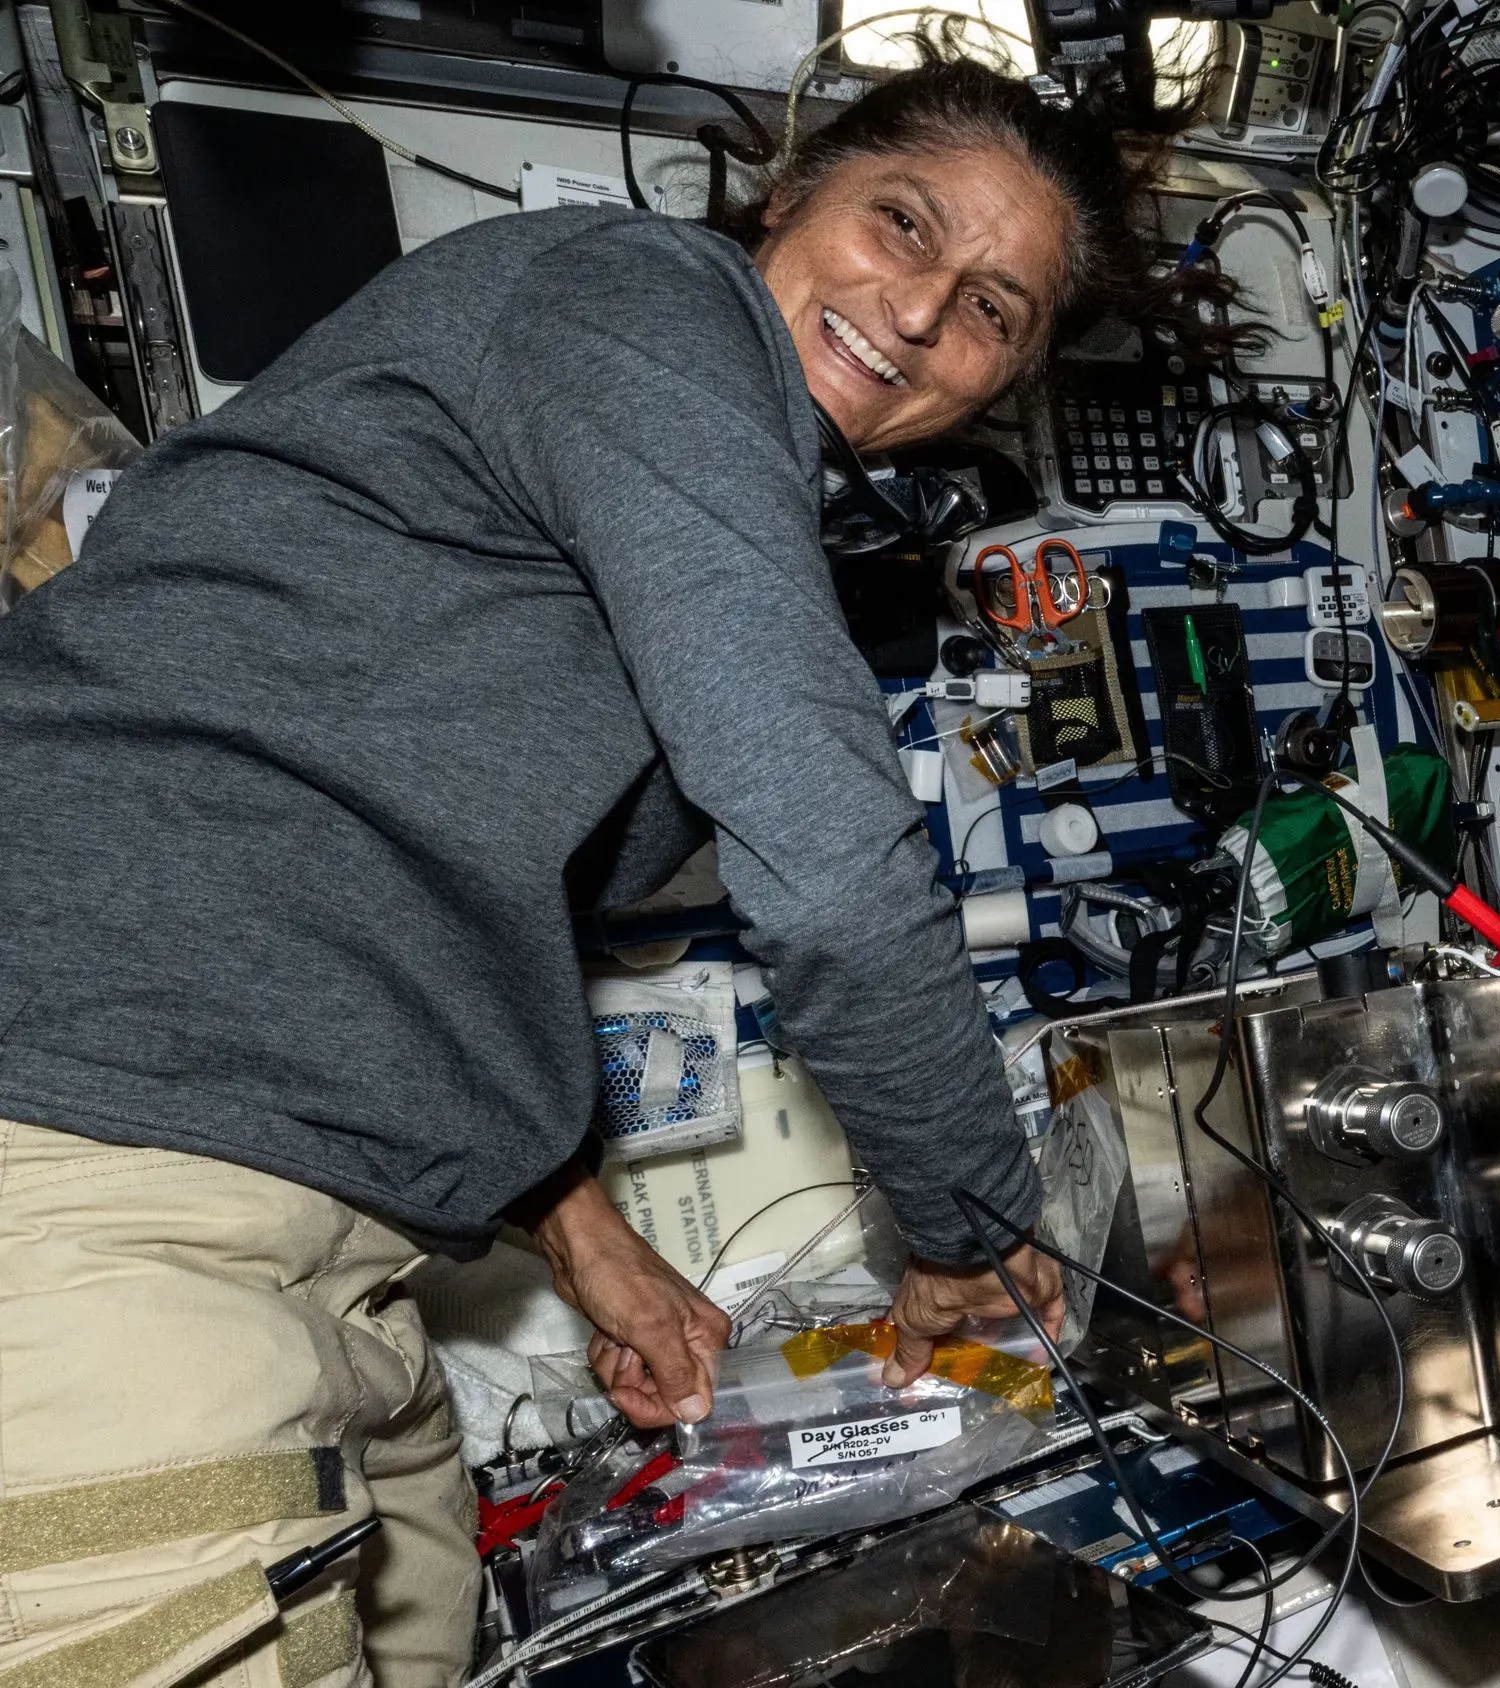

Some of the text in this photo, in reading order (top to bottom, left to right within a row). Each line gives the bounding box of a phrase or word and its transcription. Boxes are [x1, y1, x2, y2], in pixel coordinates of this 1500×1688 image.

[572, 180, 591, 188] Power
[592, 183, 610, 191] Cable
[86, 480, 106, 493] Wet
[1033, 1090, 1049, 1100] Mou
[628, 1161, 648, 1208] LEAK
[691, 1149, 721, 1257] TERNATIONAL
[678, 1196, 703, 1264] STATION
[801, 1411, 945, 1444] Day Glasses Qty 1
[843, 1436, 891, 1449] R2D2-DV
[837, 1450, 856, 1460] S/N
